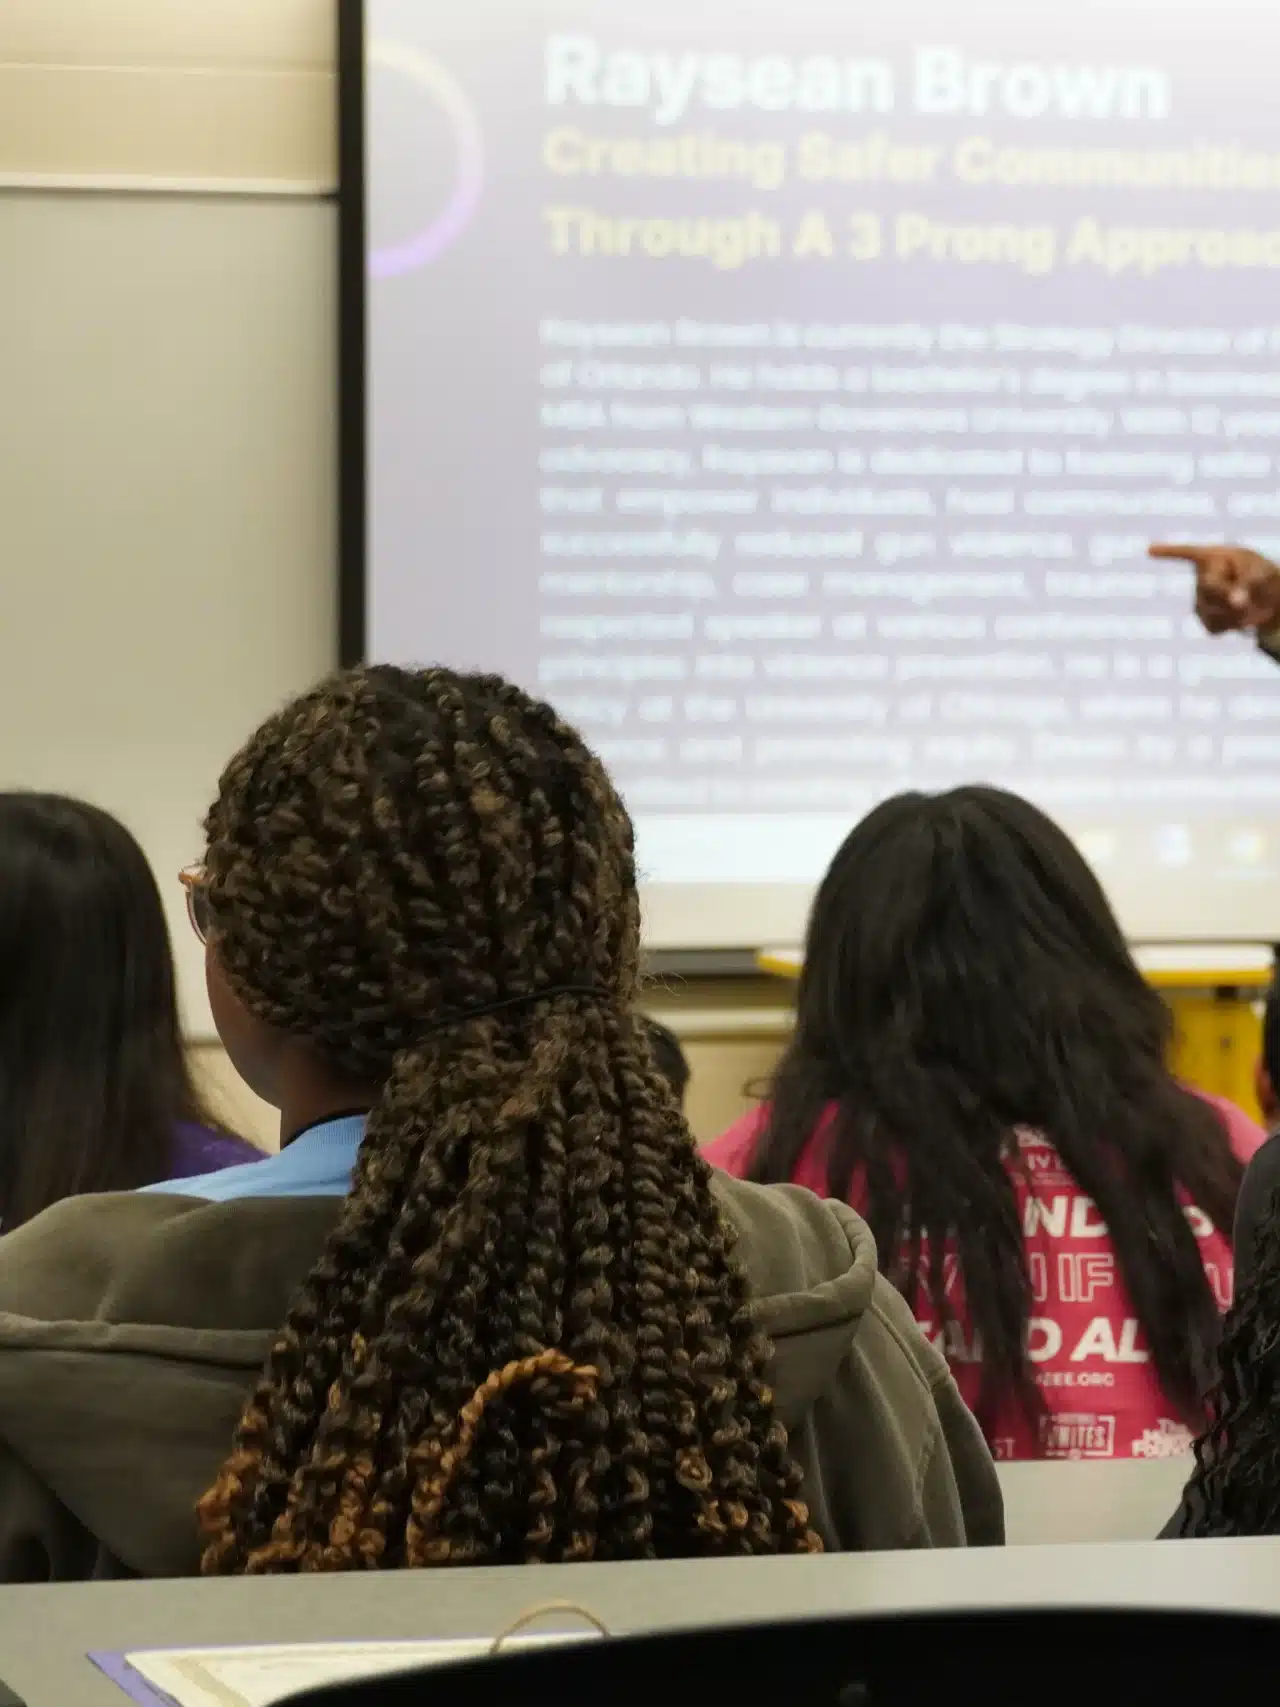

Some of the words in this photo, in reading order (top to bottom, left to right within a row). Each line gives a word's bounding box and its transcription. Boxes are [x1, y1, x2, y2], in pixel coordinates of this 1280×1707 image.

[544, 34, 892, 123] Raysean
[913, 43, 1170, 119] Brown
[544, 130, 785, 188] Creating
[799, 133, 937, 181] Safer
[543, 205, 780, 268] Through
[794, 211, 832, 257] A
[852, 212, 880, 260] 3
[897, 214, 1053, 274] Prong
